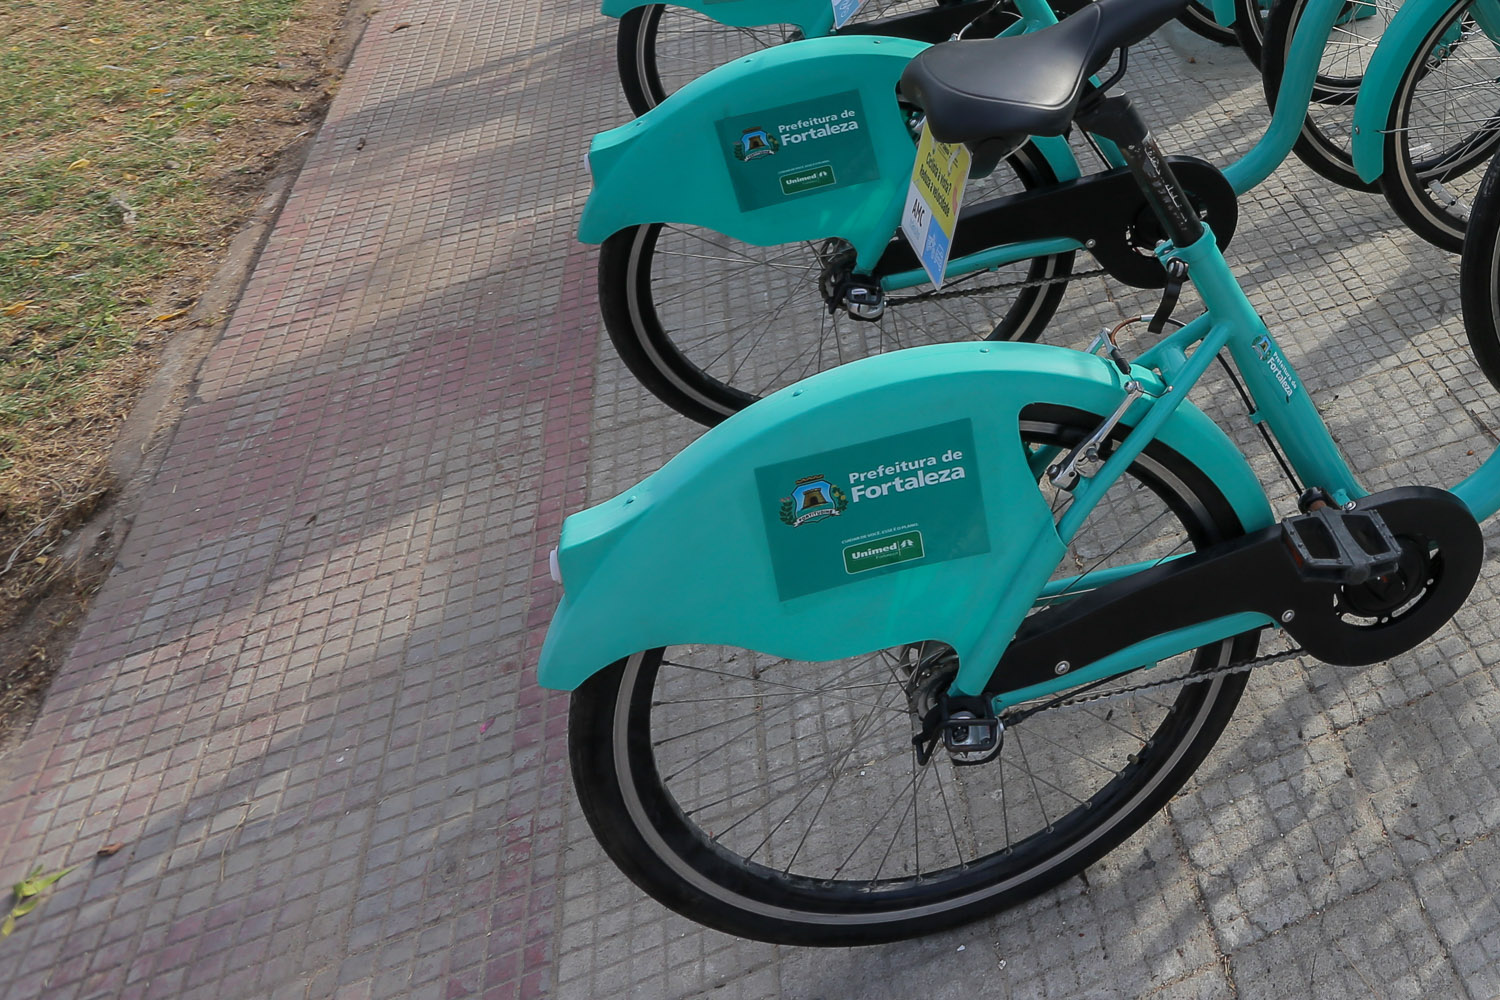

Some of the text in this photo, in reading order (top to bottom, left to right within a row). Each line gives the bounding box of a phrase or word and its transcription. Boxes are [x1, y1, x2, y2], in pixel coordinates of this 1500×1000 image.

[778, 109, 856, 134] Prefeitura de
[780, 121, 859, 147] Fortaleza
[785, 173, 817, 185] Unimed
[911, 197, 925, 228] AMC
[1267, 357, 1293, 397] Fortaleza
[1273, 351, 1297, 390] Prefeitura de
[848, 449, 963, 484] Prefeitura de
[851, 466, 966, 503] Fortaleza
[851, 542, 898, 559] Unimed
